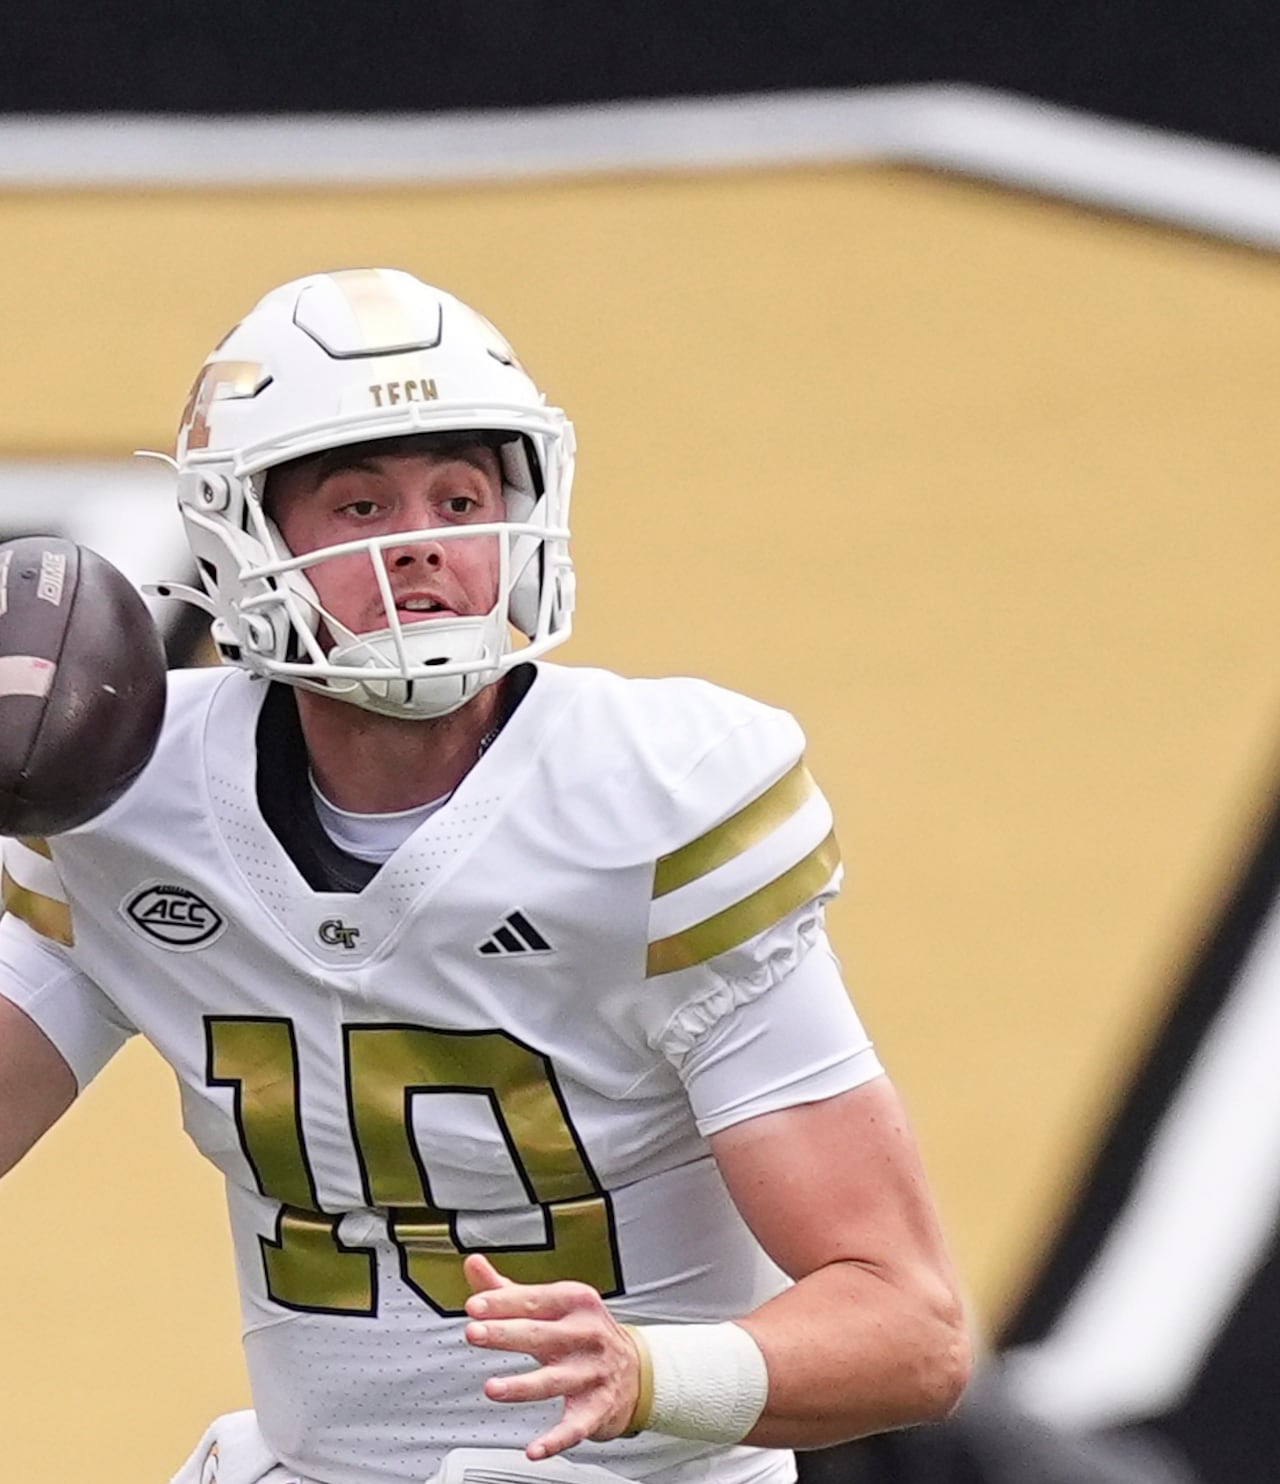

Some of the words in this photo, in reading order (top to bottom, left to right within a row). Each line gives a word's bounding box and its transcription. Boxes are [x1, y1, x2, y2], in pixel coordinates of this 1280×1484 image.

[368, 378, 440, 408] TECH
[141, 898, 208, 924] ACC
[319, 918, 361, 950] GT
[202, 1014, 626, 1319] 10
